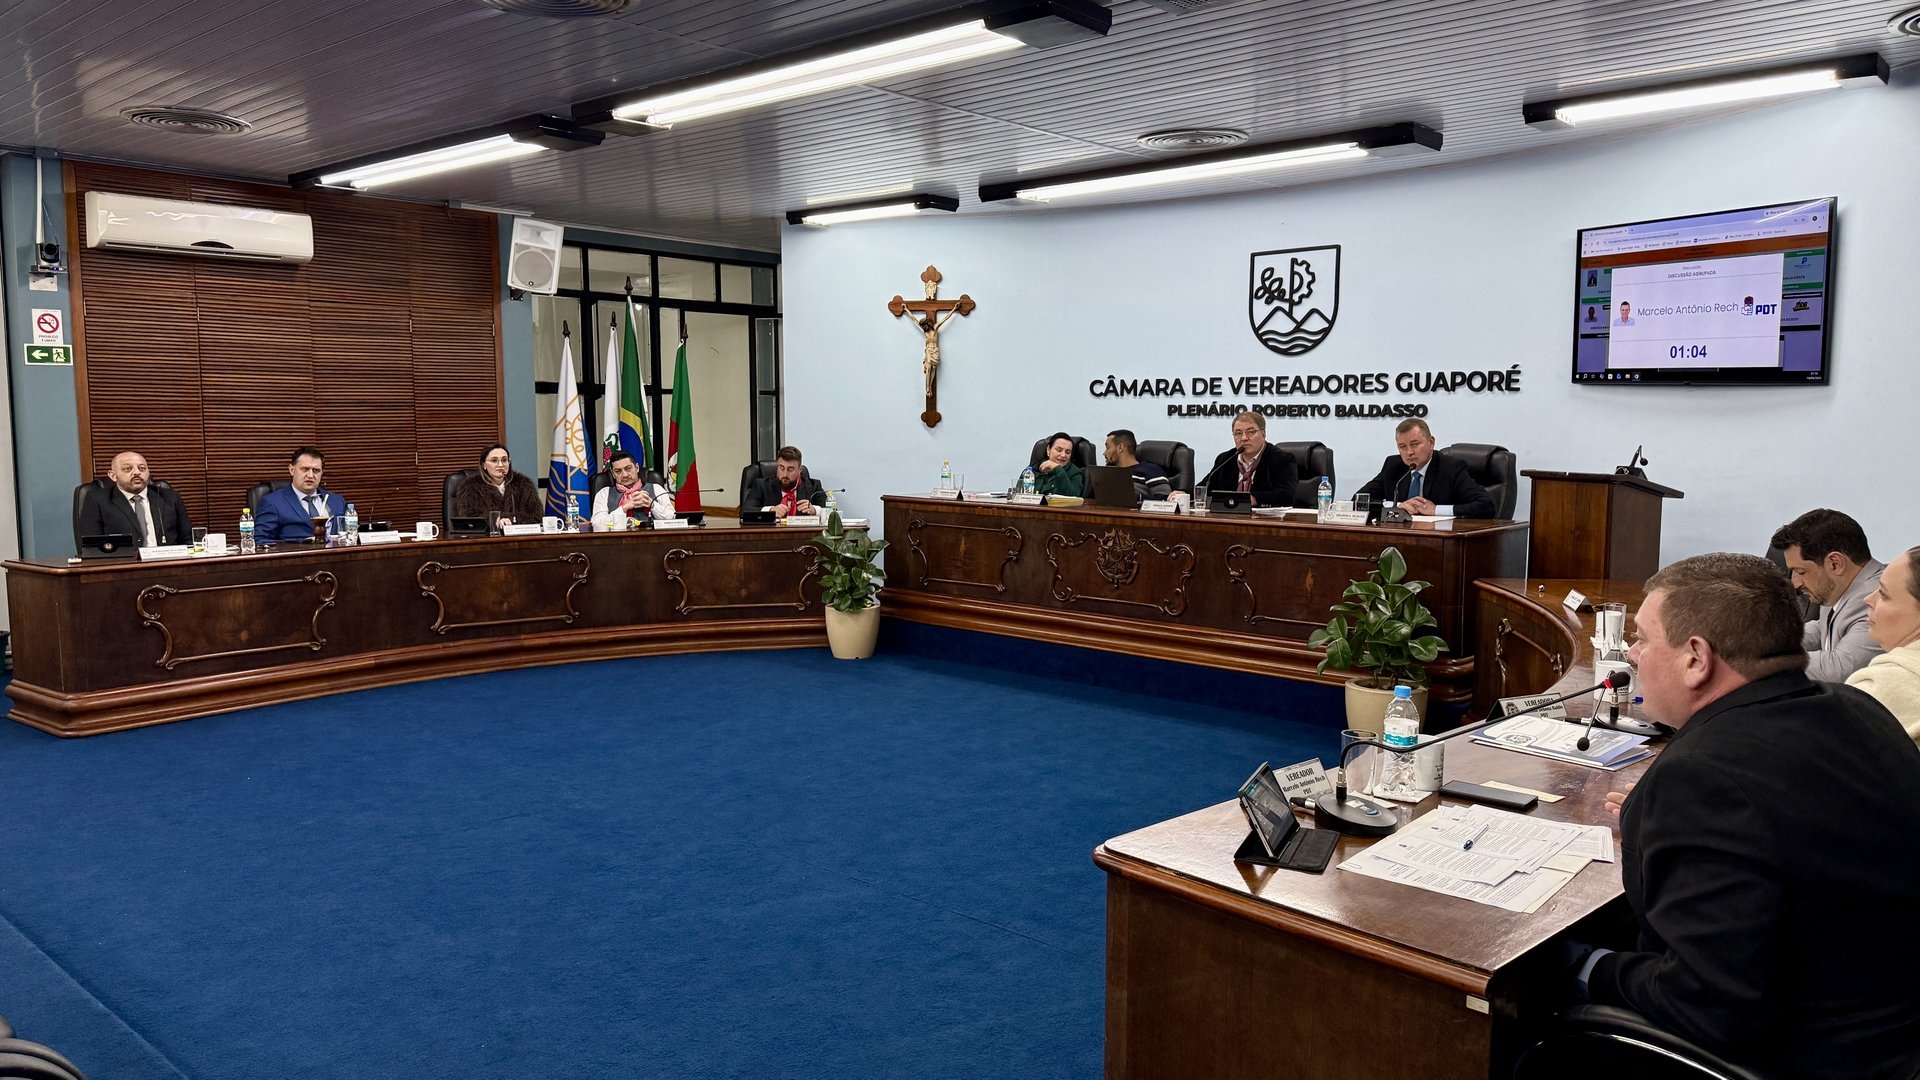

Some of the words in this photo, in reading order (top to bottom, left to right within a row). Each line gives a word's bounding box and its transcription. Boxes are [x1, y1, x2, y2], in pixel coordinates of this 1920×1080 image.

[1667, 271, 1692, 279] DISCUSSÃO
[1637, 306, 1673, 316] Marcelo
[1675, 303, 1712, 314] Antônio
[1714, 302, 1739, 313] Rech
[1755, 304, 1777, 315] PDT
[1669, 345, 1707, 358] 01:04
[1089, 375, 1186, 397] CÂMARA
[1191, 377, 1223, 396] DE
[1228, 373, 1389, 396] VEREADORES
[1395, 364, 1521, 392] GUAPORÉ
[1167, 401, 1247, 417] PLENÁRIO
[1252, 404, 1330, 417] ROBERTO
[1334, 404, 1428, 418] BALDASSO
[1285, 767, 1315, 782] VEREADOR
[1282, 783, 1300, 792] Marcelo
[1302, 787, 1312, 796] PDT
